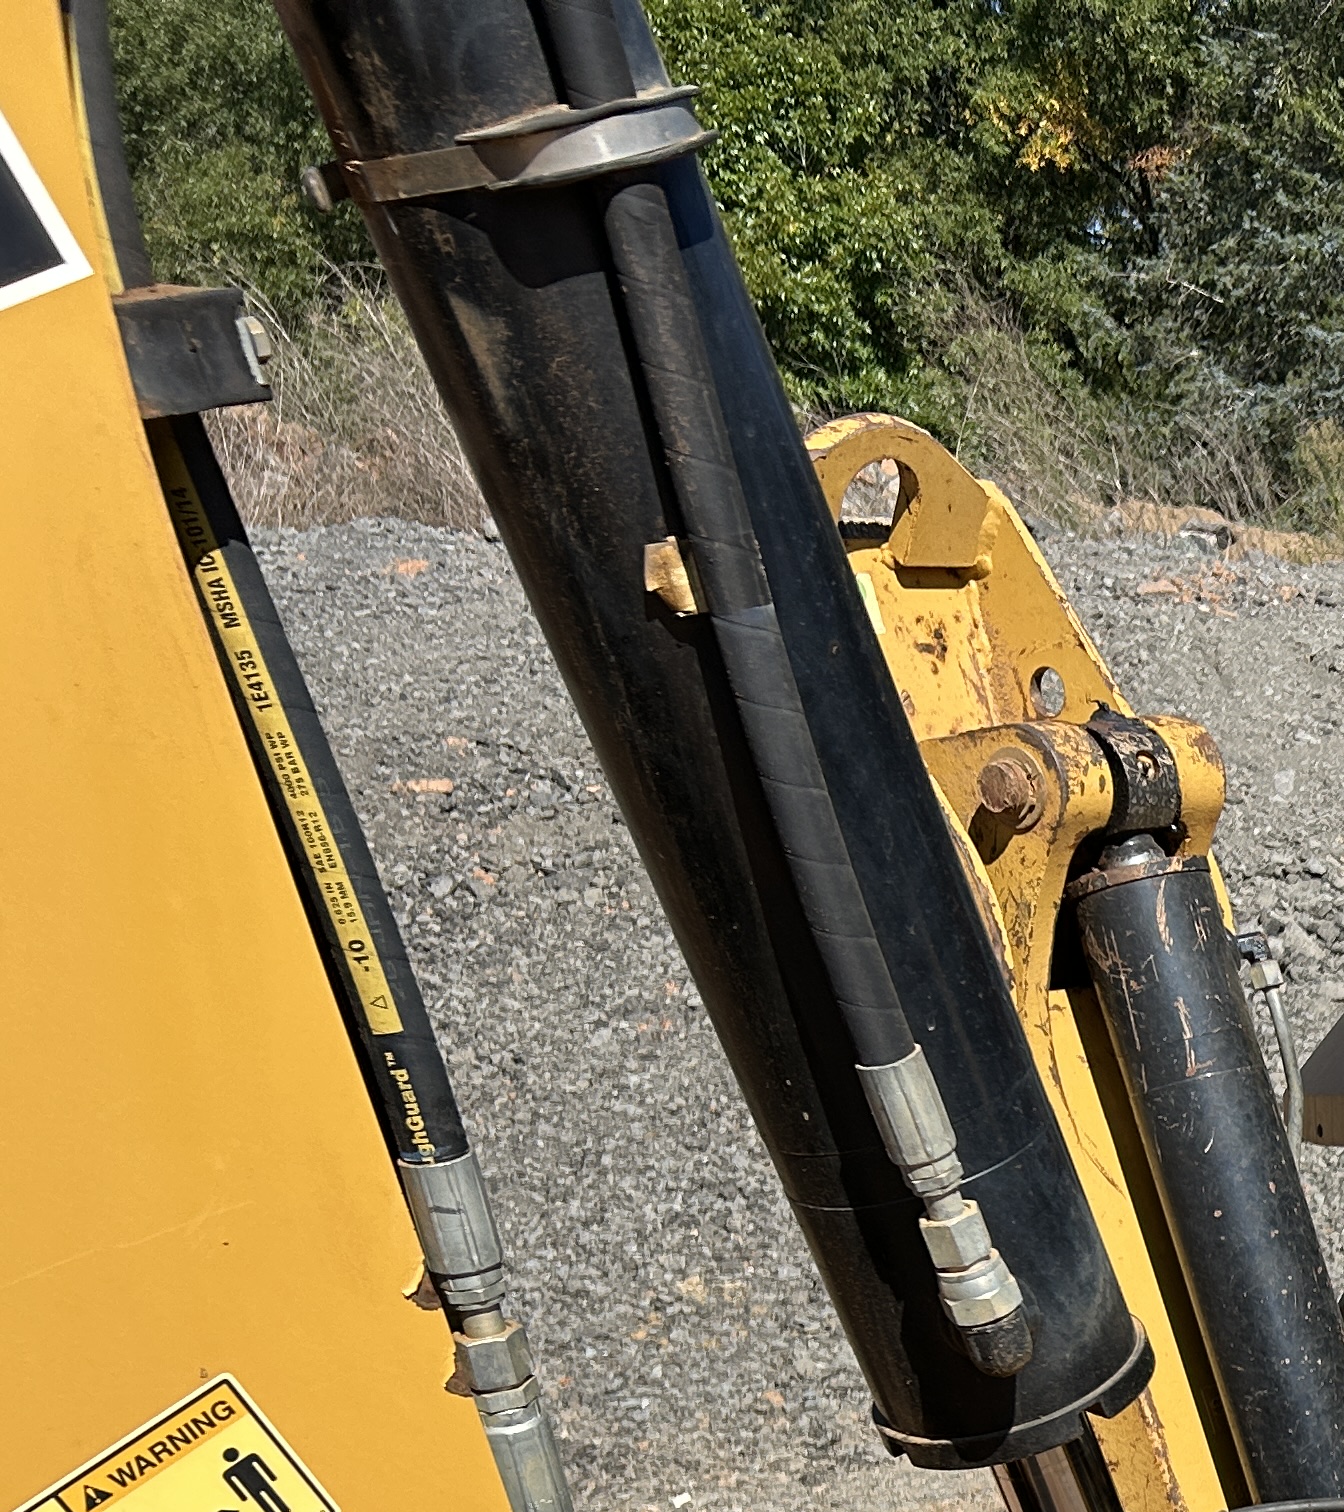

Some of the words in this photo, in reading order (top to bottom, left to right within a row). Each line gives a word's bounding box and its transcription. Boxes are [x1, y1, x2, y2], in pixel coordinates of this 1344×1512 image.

[206, 576, 241, 630] MSHA
[234, 649, 273, 712] 1E4135
[264, 732, 278, 748] WP
[275, 730, 290, 748] WP
[272, 751, 287, 771] PSI
[284, 752, 301, 774] BAR
[335, 880, 348, 899] MM
[108, 1398, 237, 1489] WARNING
